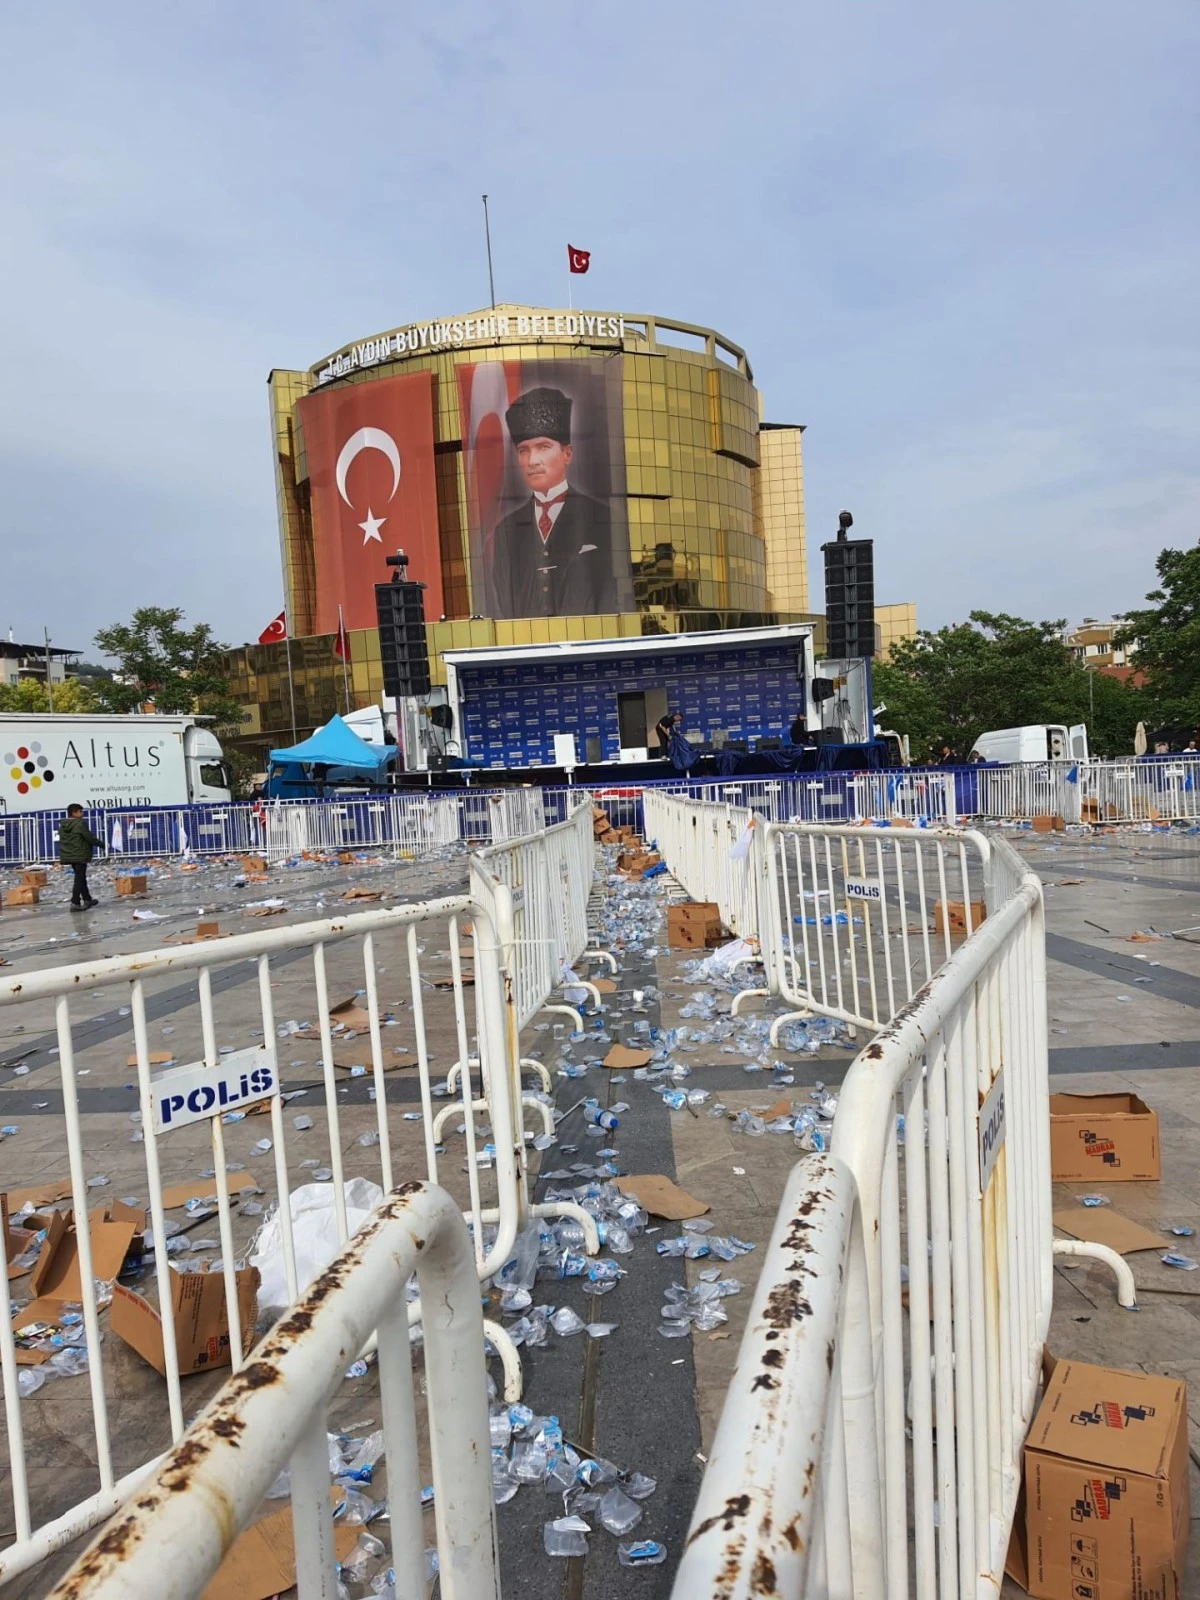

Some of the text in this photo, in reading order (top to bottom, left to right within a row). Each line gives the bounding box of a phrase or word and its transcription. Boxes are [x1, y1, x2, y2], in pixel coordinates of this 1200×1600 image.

[350, 335, 391, 368] AYDIN
[396, 310, 510, 353] BÜYÜKŞEHİR
[517, 310, 625, 338] BELEDİYESİ
[62, 738, 161, 768] Altus
[90, 784, 145, 793] www.altusorg.com
